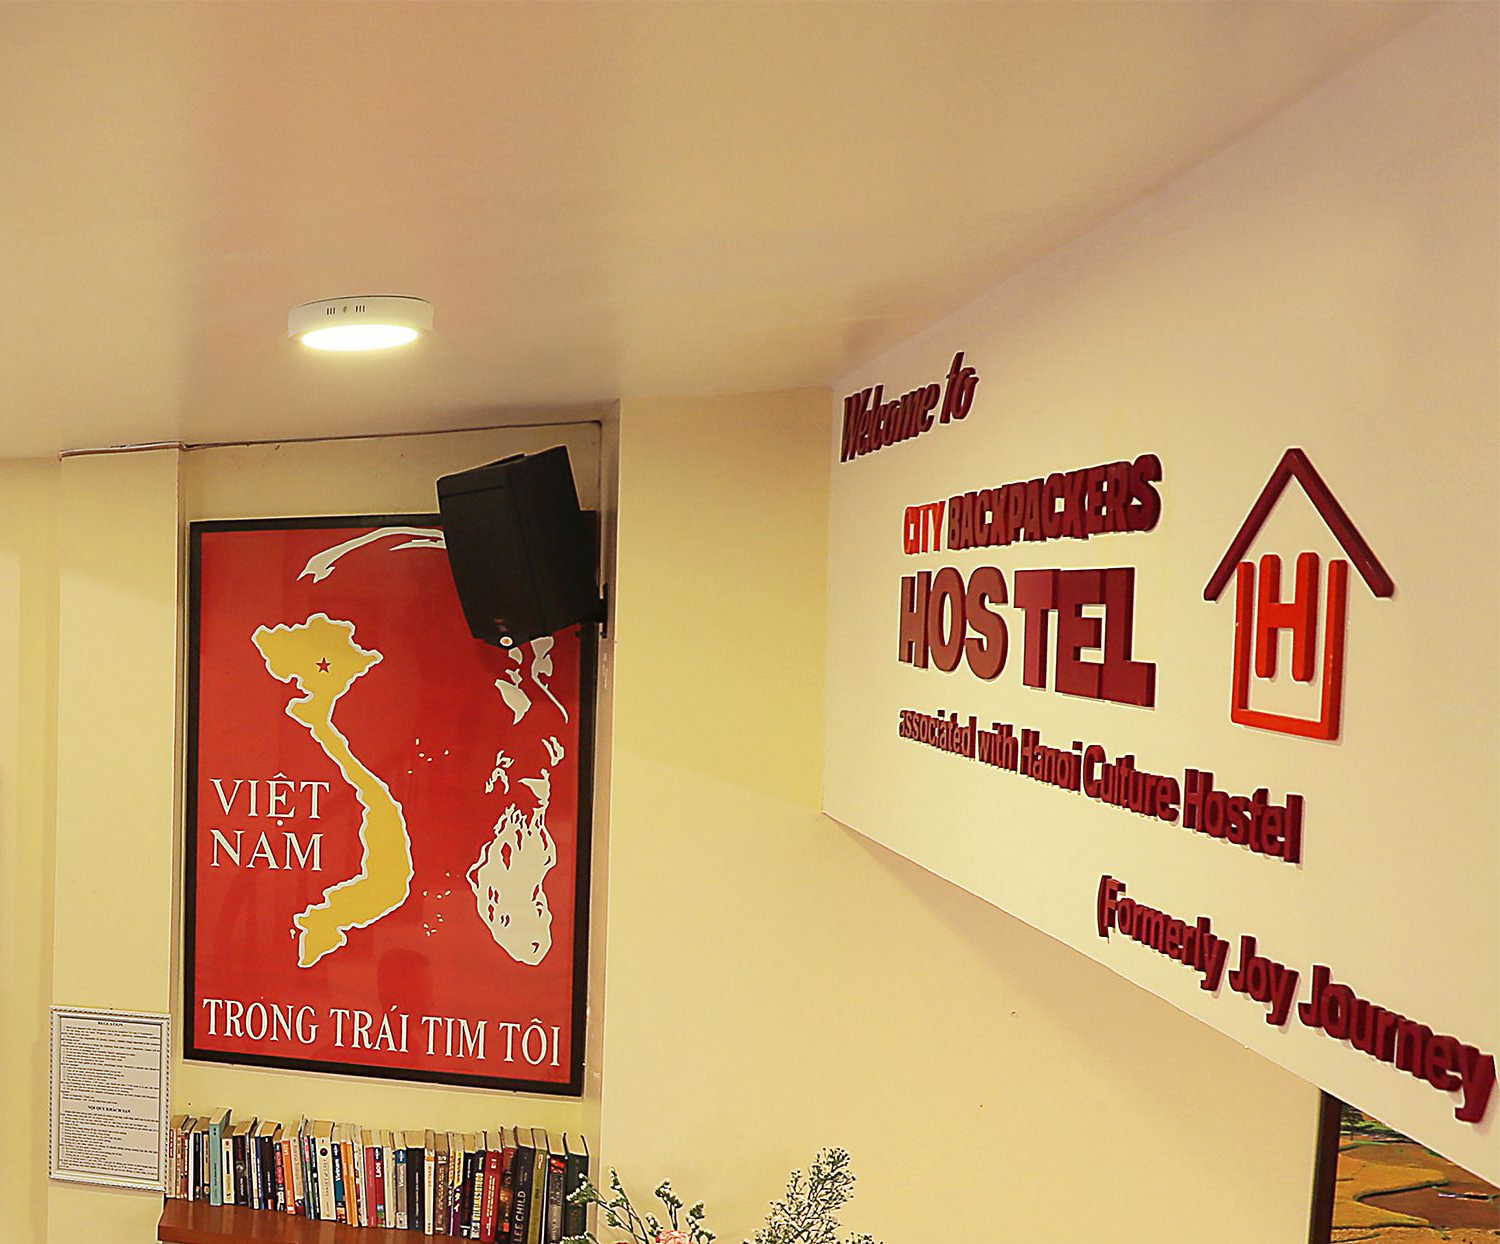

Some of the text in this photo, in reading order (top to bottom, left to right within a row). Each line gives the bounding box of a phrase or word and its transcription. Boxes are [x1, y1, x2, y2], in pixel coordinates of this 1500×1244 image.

[840, 351, 980, 463] Welcome to
[903, 453, 1163, 555] CITY BACKPACKERS
[898, 565, 1157, 711] HOSTEL
[209, 772, 330, 828] VIỆT
[899, 708, 1305, 865] associated with Hanoi Culture Hostel
[209, 829, 324, 872] NAM
[202, 997, 562, 1067] TRONG TRÁI TIM TÔI
[1229, 935, 1299, 1027] Joy
[1298, 964, 1497, 1124] Journey
[514, 1189, 526, 1222] CHILD
